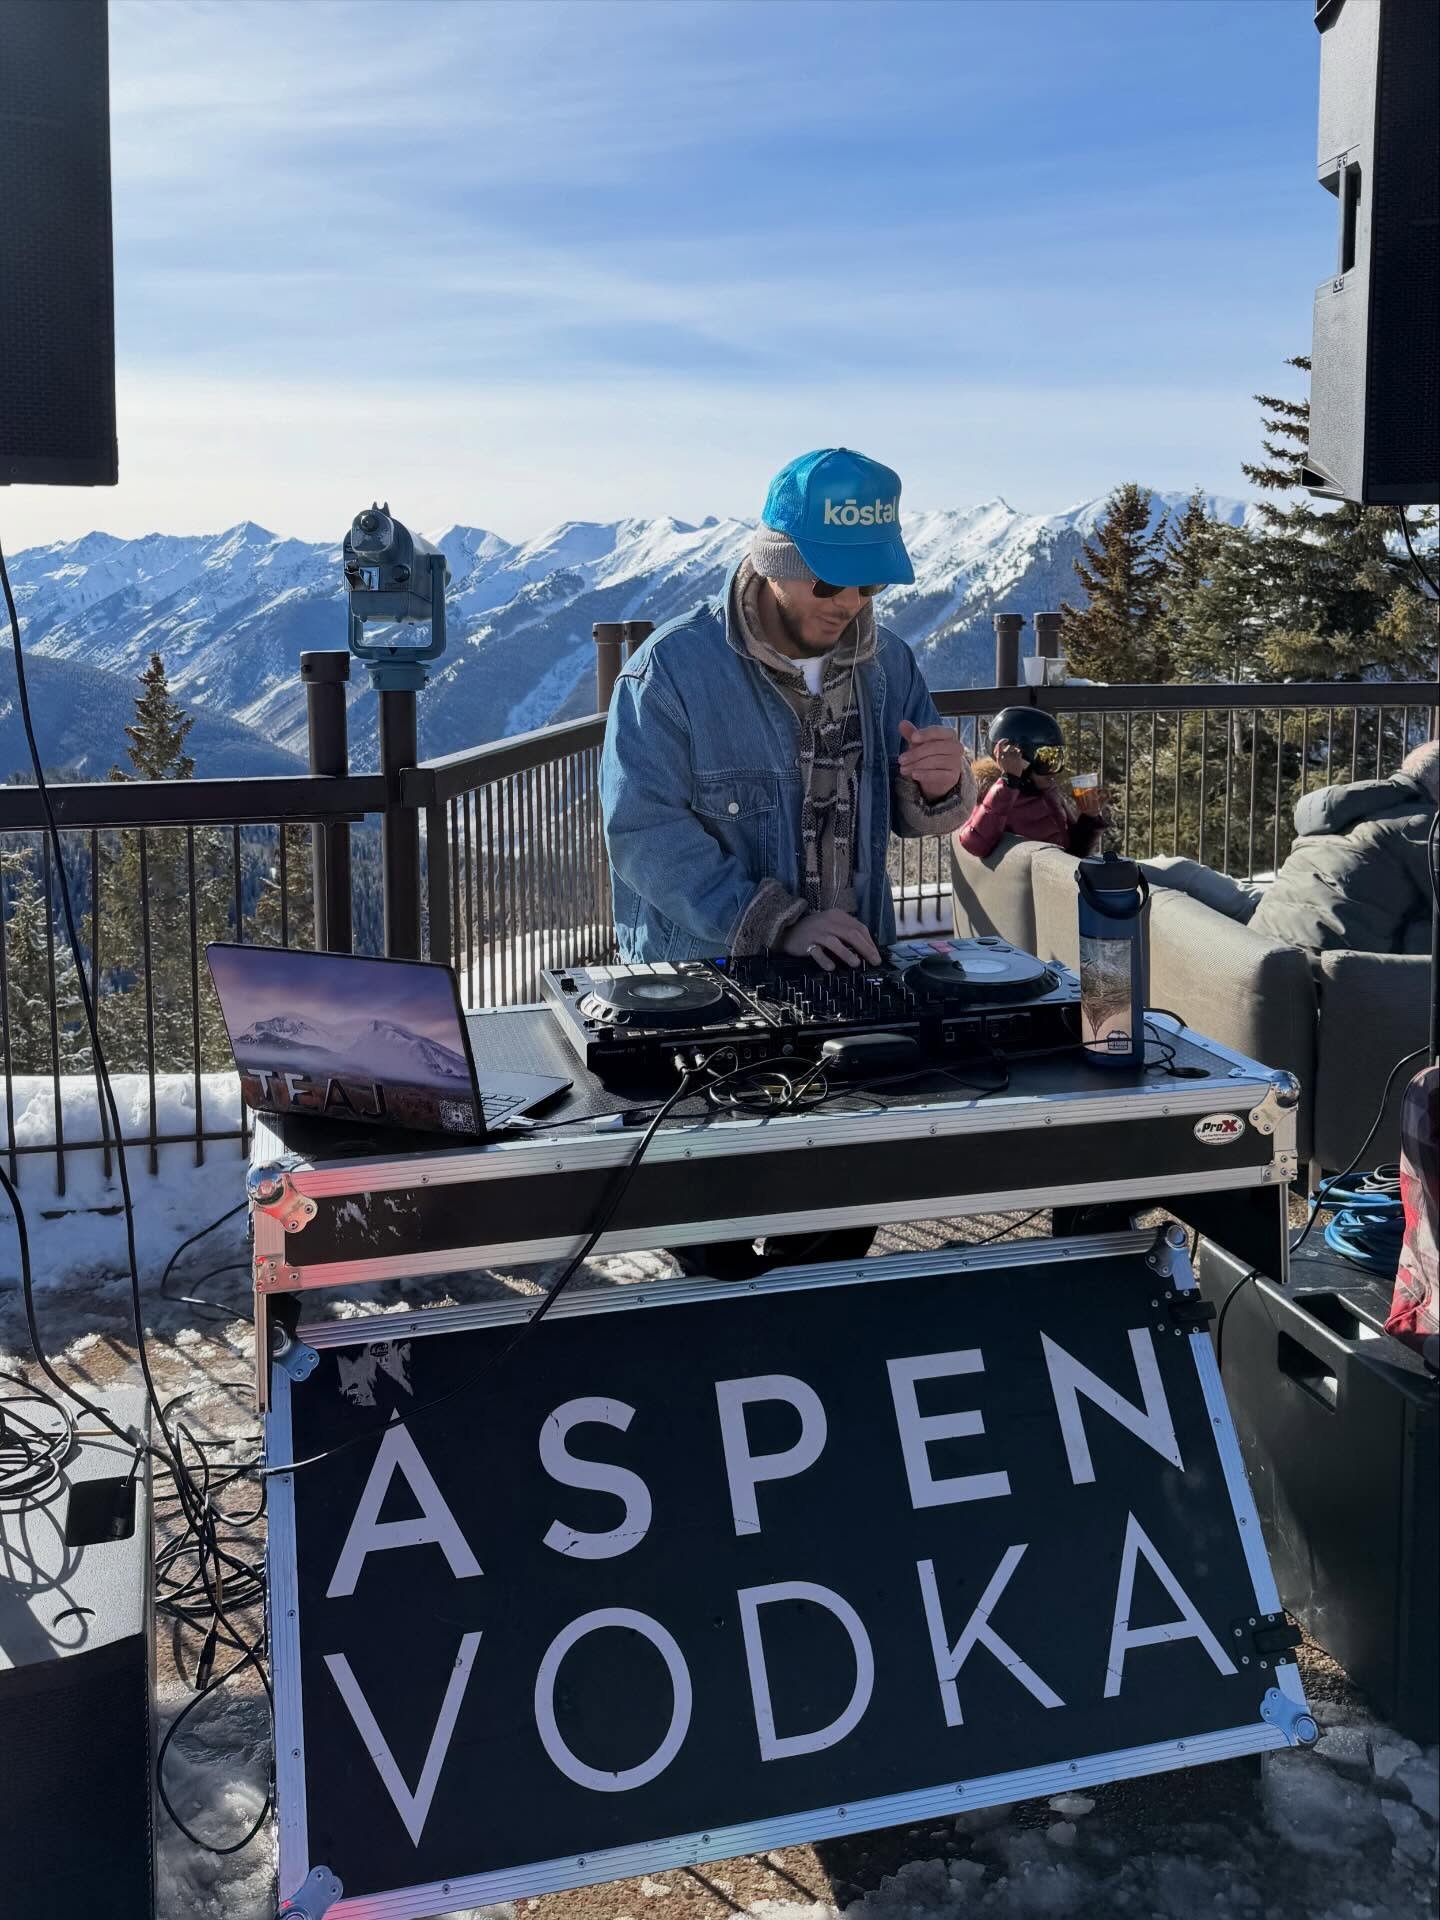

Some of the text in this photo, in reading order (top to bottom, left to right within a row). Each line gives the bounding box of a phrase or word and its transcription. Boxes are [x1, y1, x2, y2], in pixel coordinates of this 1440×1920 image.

[1202, 1120, 1238, 1133] ProX
[325, 1327, 1185, 1598] ASPEN
[323, 1510, 1239, 1848] VODKA
